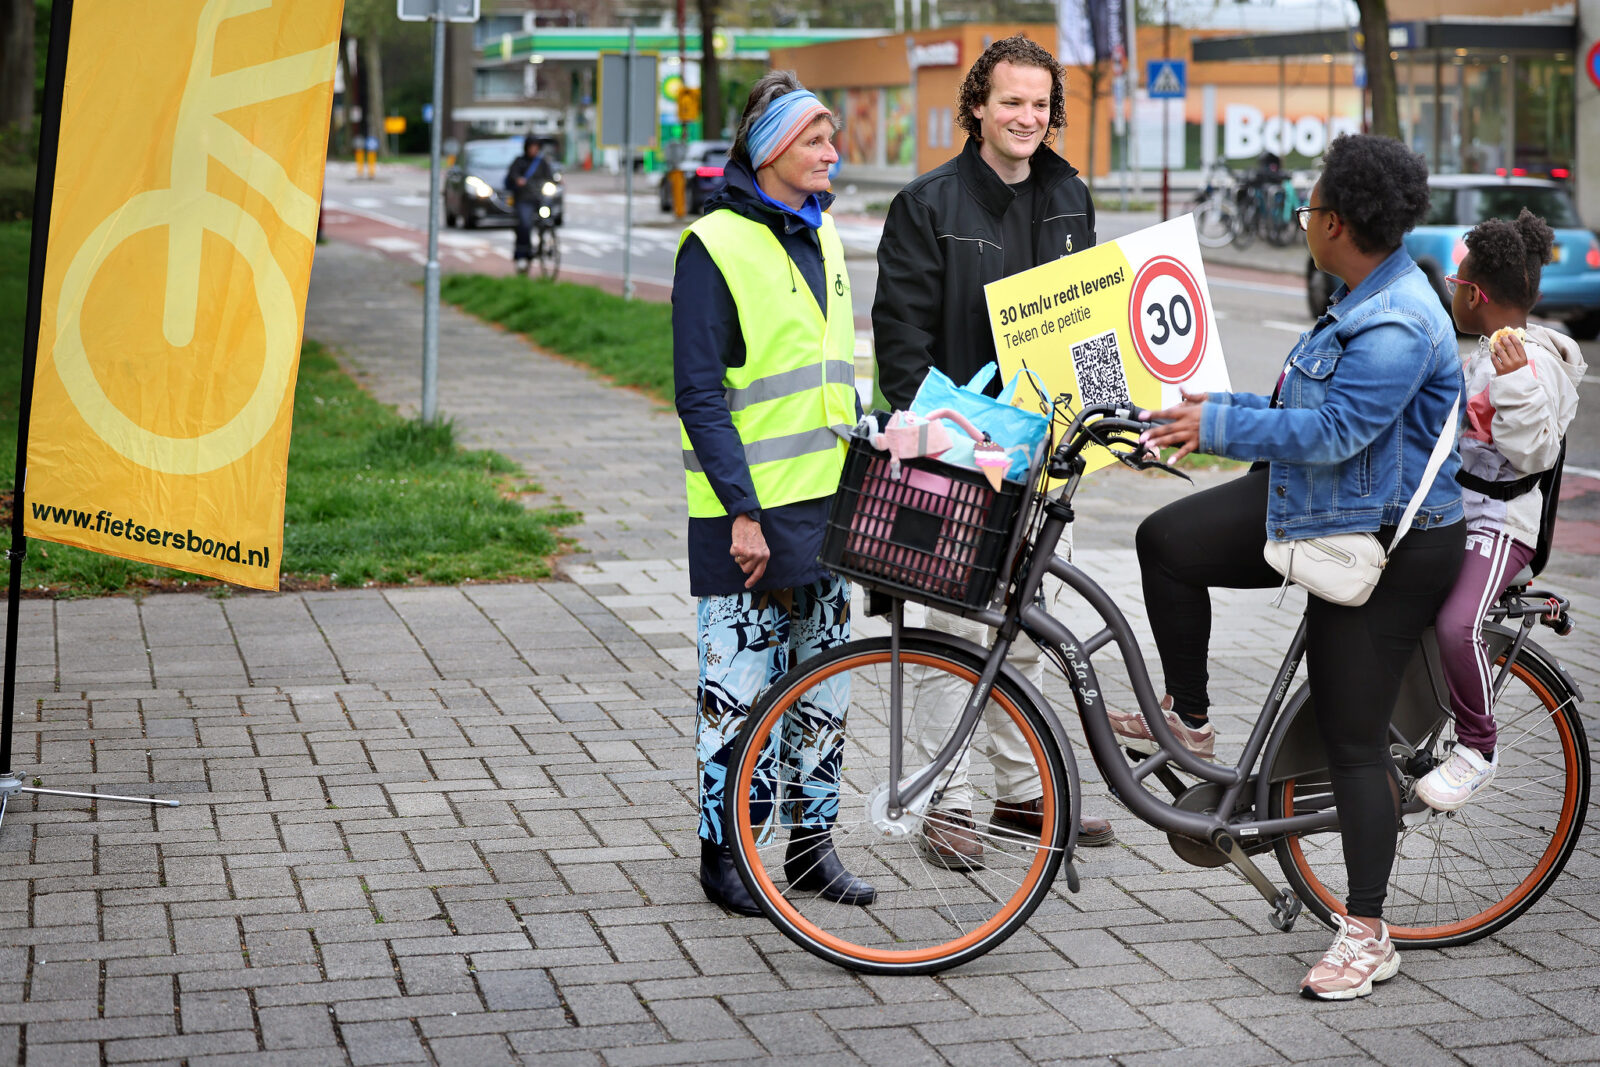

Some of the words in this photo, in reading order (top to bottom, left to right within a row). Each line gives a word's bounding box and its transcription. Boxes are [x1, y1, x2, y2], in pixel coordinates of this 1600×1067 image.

[1000, 305, 1018, 326] 30
[1020, 294, 1053, 319] km/u
[1053, 284, 1080, 307] redt
[1081, 267, 1125, 298] levens!
[1146, 294, 1192, 346] 30
[1004, 326, 1039, 349] Teken
[1041, 317, 1055, 335] de
[1057, 306, 1091, 334] petitie
[31, 502, 270, 569] www.fietsersbond.nl
[1275, 659, 1299, 702] SPARTA
